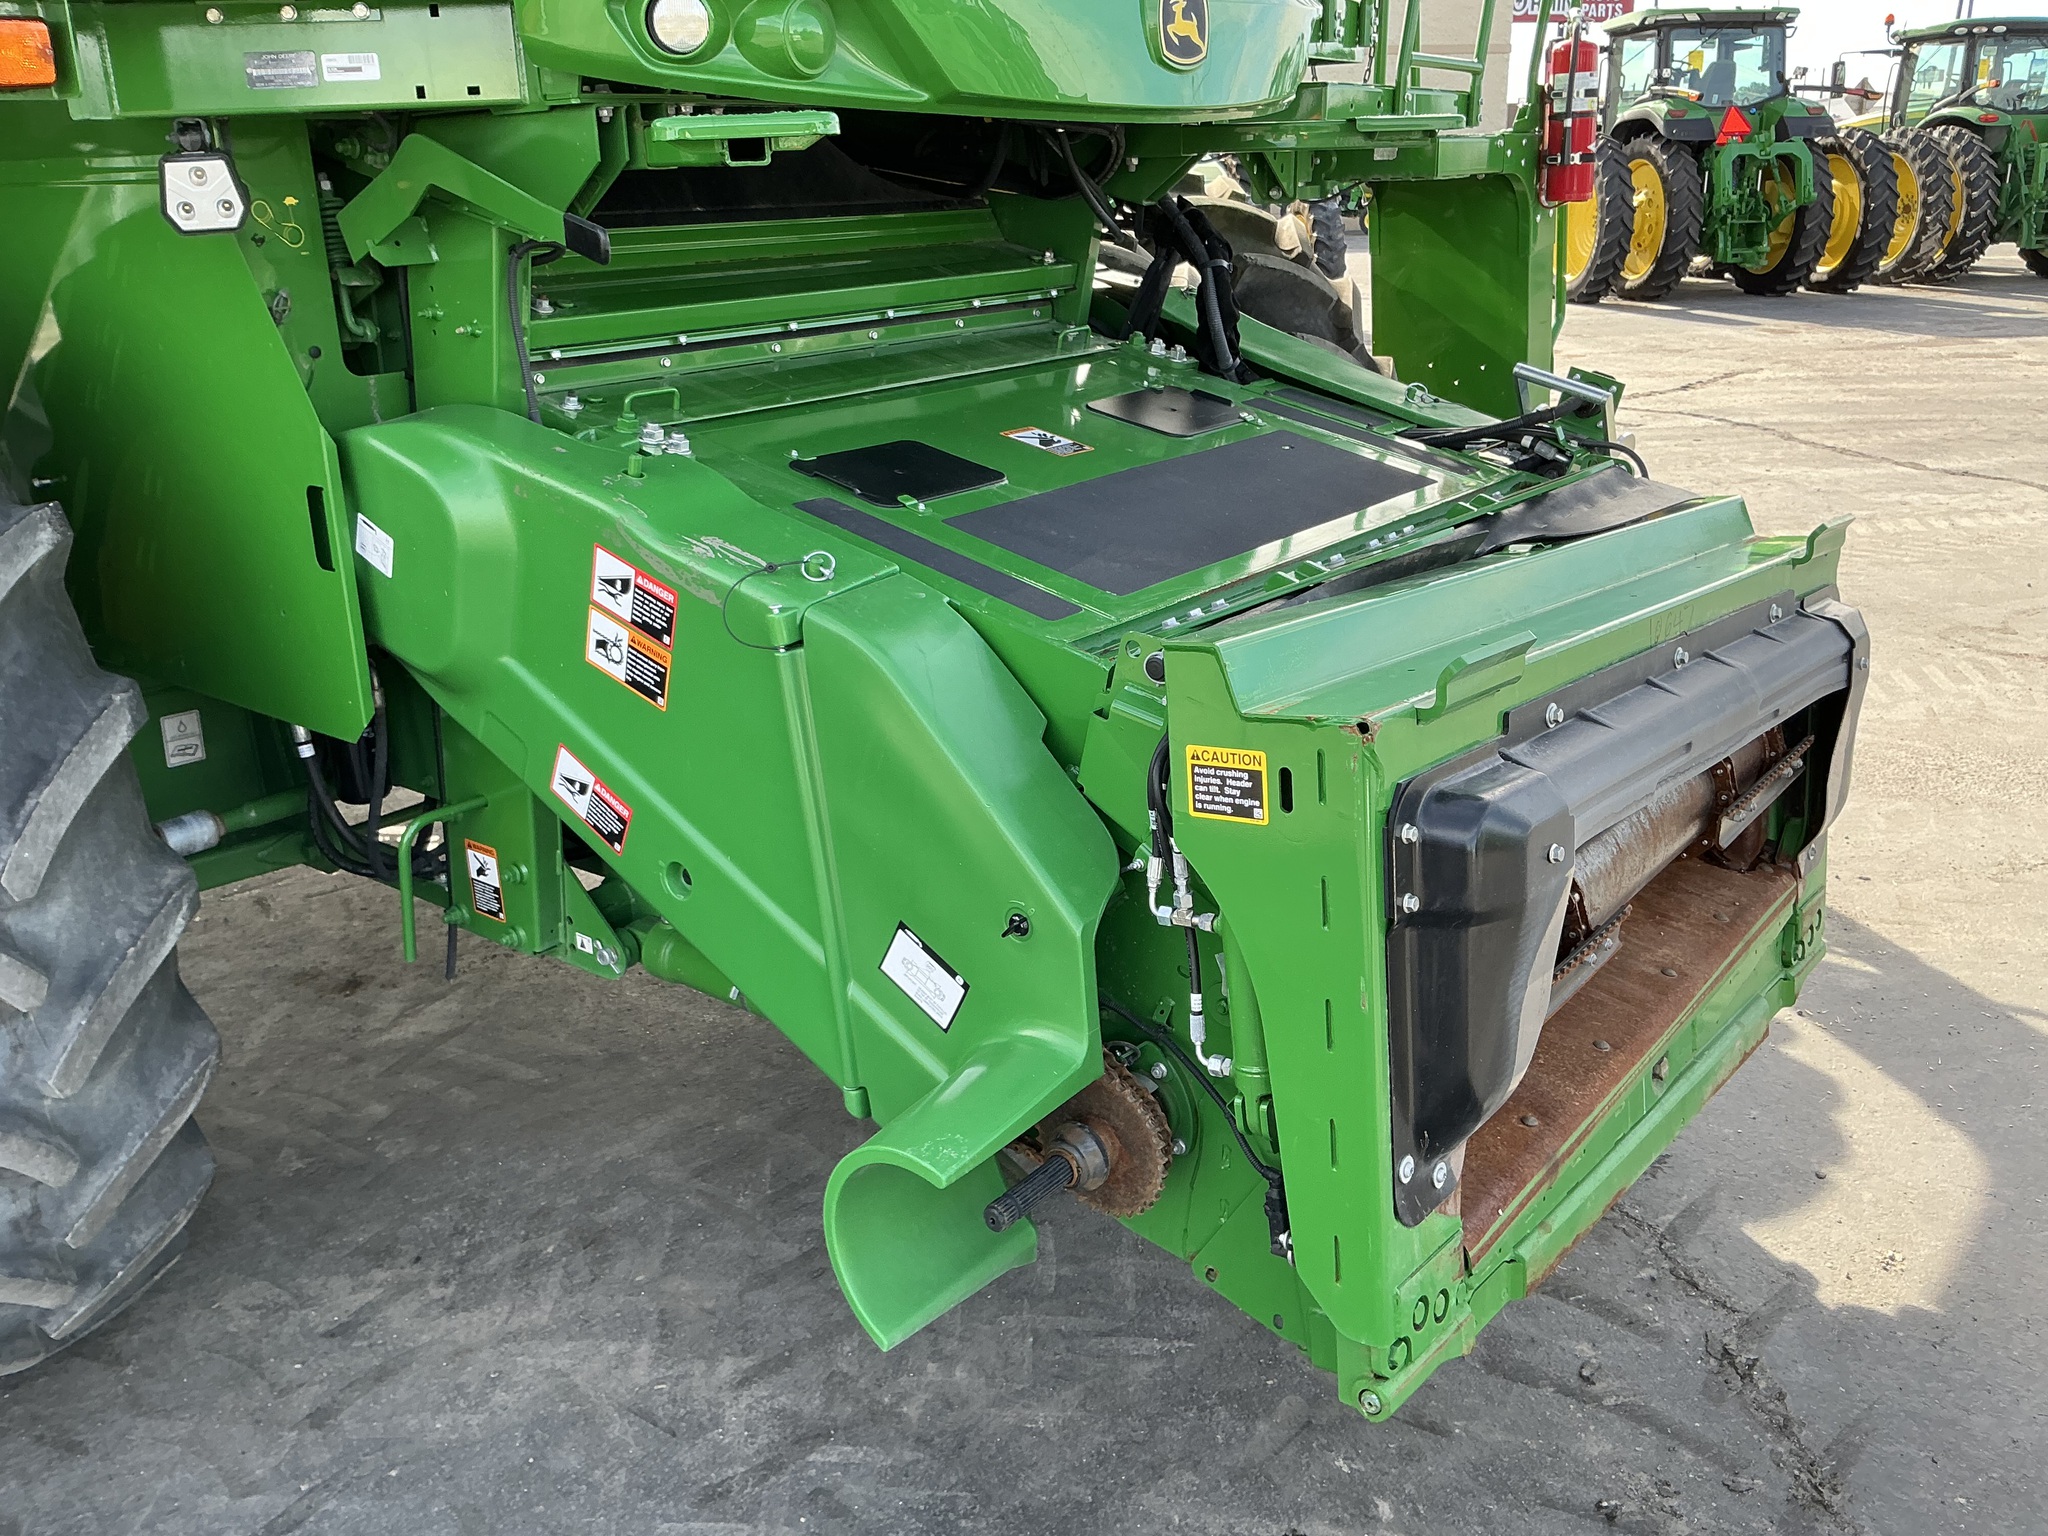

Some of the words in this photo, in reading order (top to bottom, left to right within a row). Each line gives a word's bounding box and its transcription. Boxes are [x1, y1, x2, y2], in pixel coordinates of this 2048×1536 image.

[1581, 3, 1623, 18] PARTS
[643, 578, 675, 604] DANGER
[637, 640, 668, 664] WARNING
[1201, 750, 1262, 767] CAUTION
[1194, 766, 1215, 776] Avoid
[1216, 769, 1249, 780] crushing
[1194, 775, 1223, 785] injuries.
[1226, 778, 1253, 788] Header
[1209, 785, 1221, 793] tilt.
[1224, 787, 1241, 797] Stay
[601, 790, 630, 818] DANGER
[1195, 793, 1213, 801] clear
[1214, 795, 1234, 803] when
[1235, 798, 1260, 807] engine
[1195, 801, 1202, 809] is
[1203, 803, 1234, 814] running.
